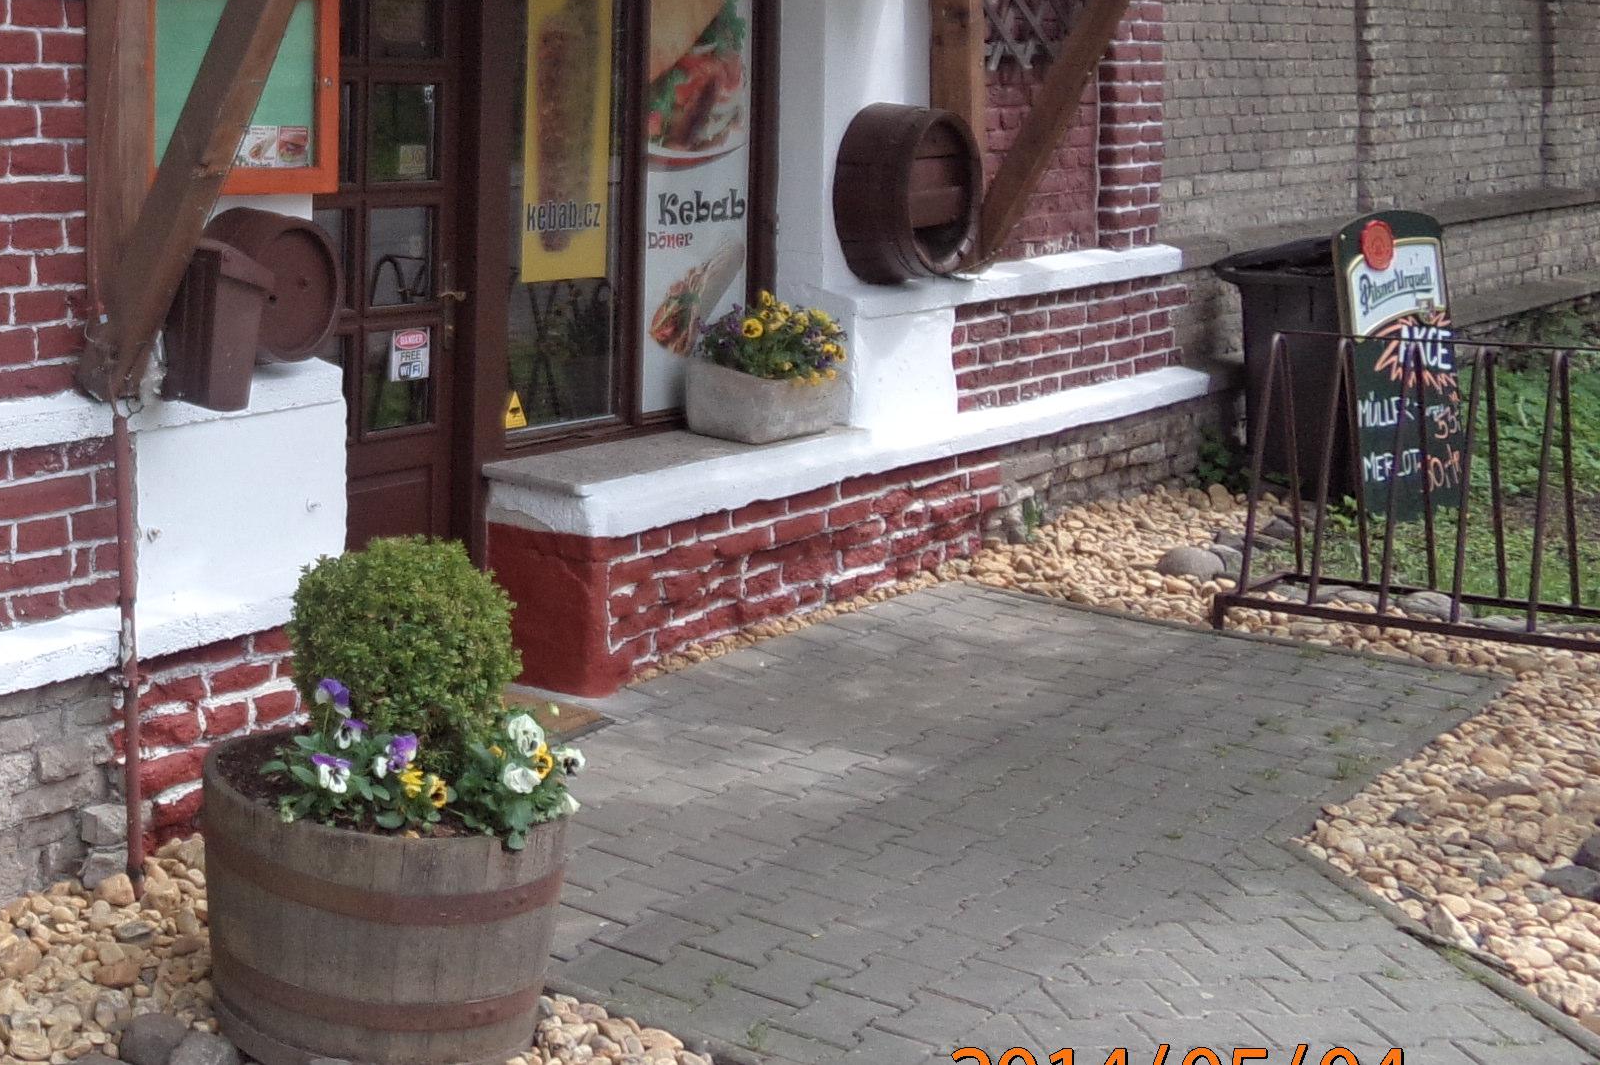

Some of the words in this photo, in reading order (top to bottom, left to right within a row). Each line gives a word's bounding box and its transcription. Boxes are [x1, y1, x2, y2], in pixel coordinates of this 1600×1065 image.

[526, 199, 601, 232] kebab.cz
[657, 187, 746, 227] Kebab
[647, 231, 694, 250] Döner
[1359, 273, 1397, 316] Pilsner
[1394, 266, 1432, 296] Urquell
[400, 349, 422, 362] FREE
[1399, 325, 1452, 370] AKCE
[1363, 449, 1421, 483] MEROT
